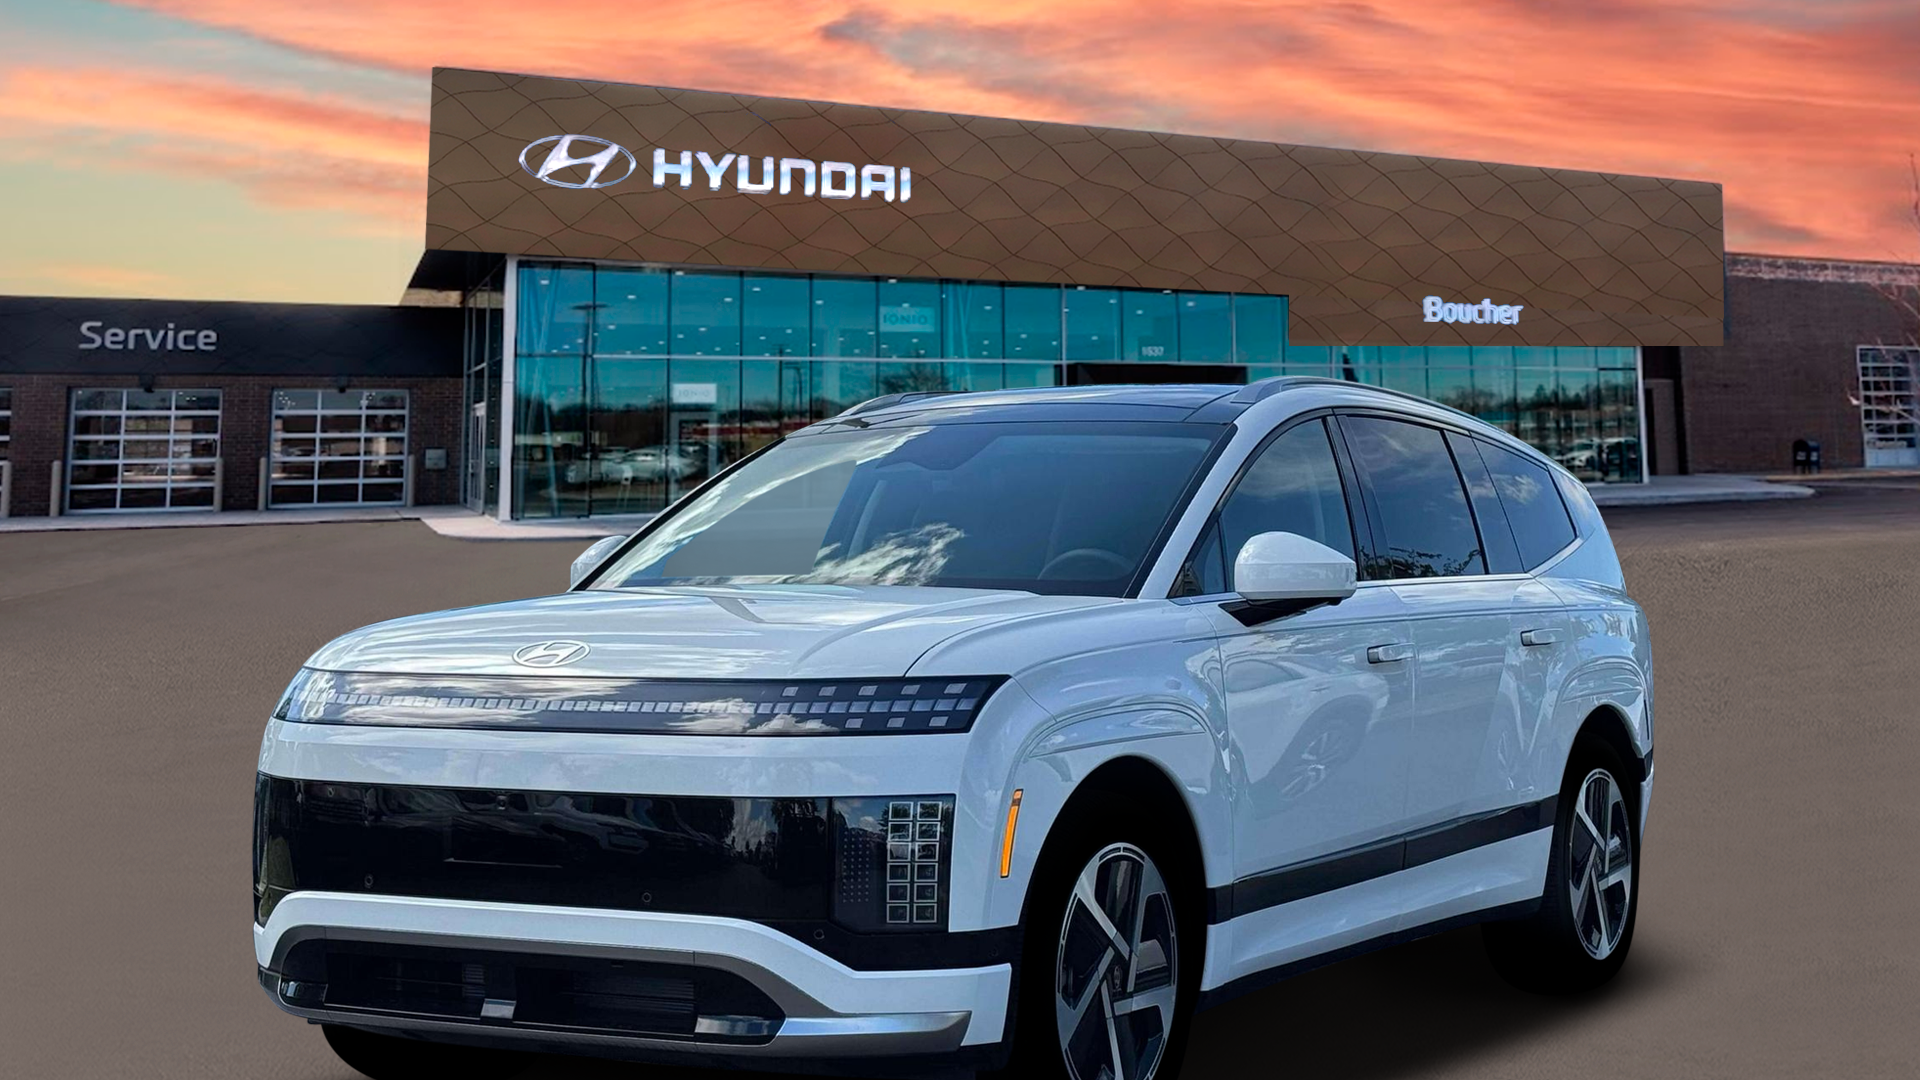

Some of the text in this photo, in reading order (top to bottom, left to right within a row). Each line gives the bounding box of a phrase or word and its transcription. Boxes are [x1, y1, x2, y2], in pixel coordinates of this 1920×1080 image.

[653, 148, 912, 203] HYUNDAI
[1422, 295, 1524, 325] Boucher
[79, 321, 218, 352] Service
